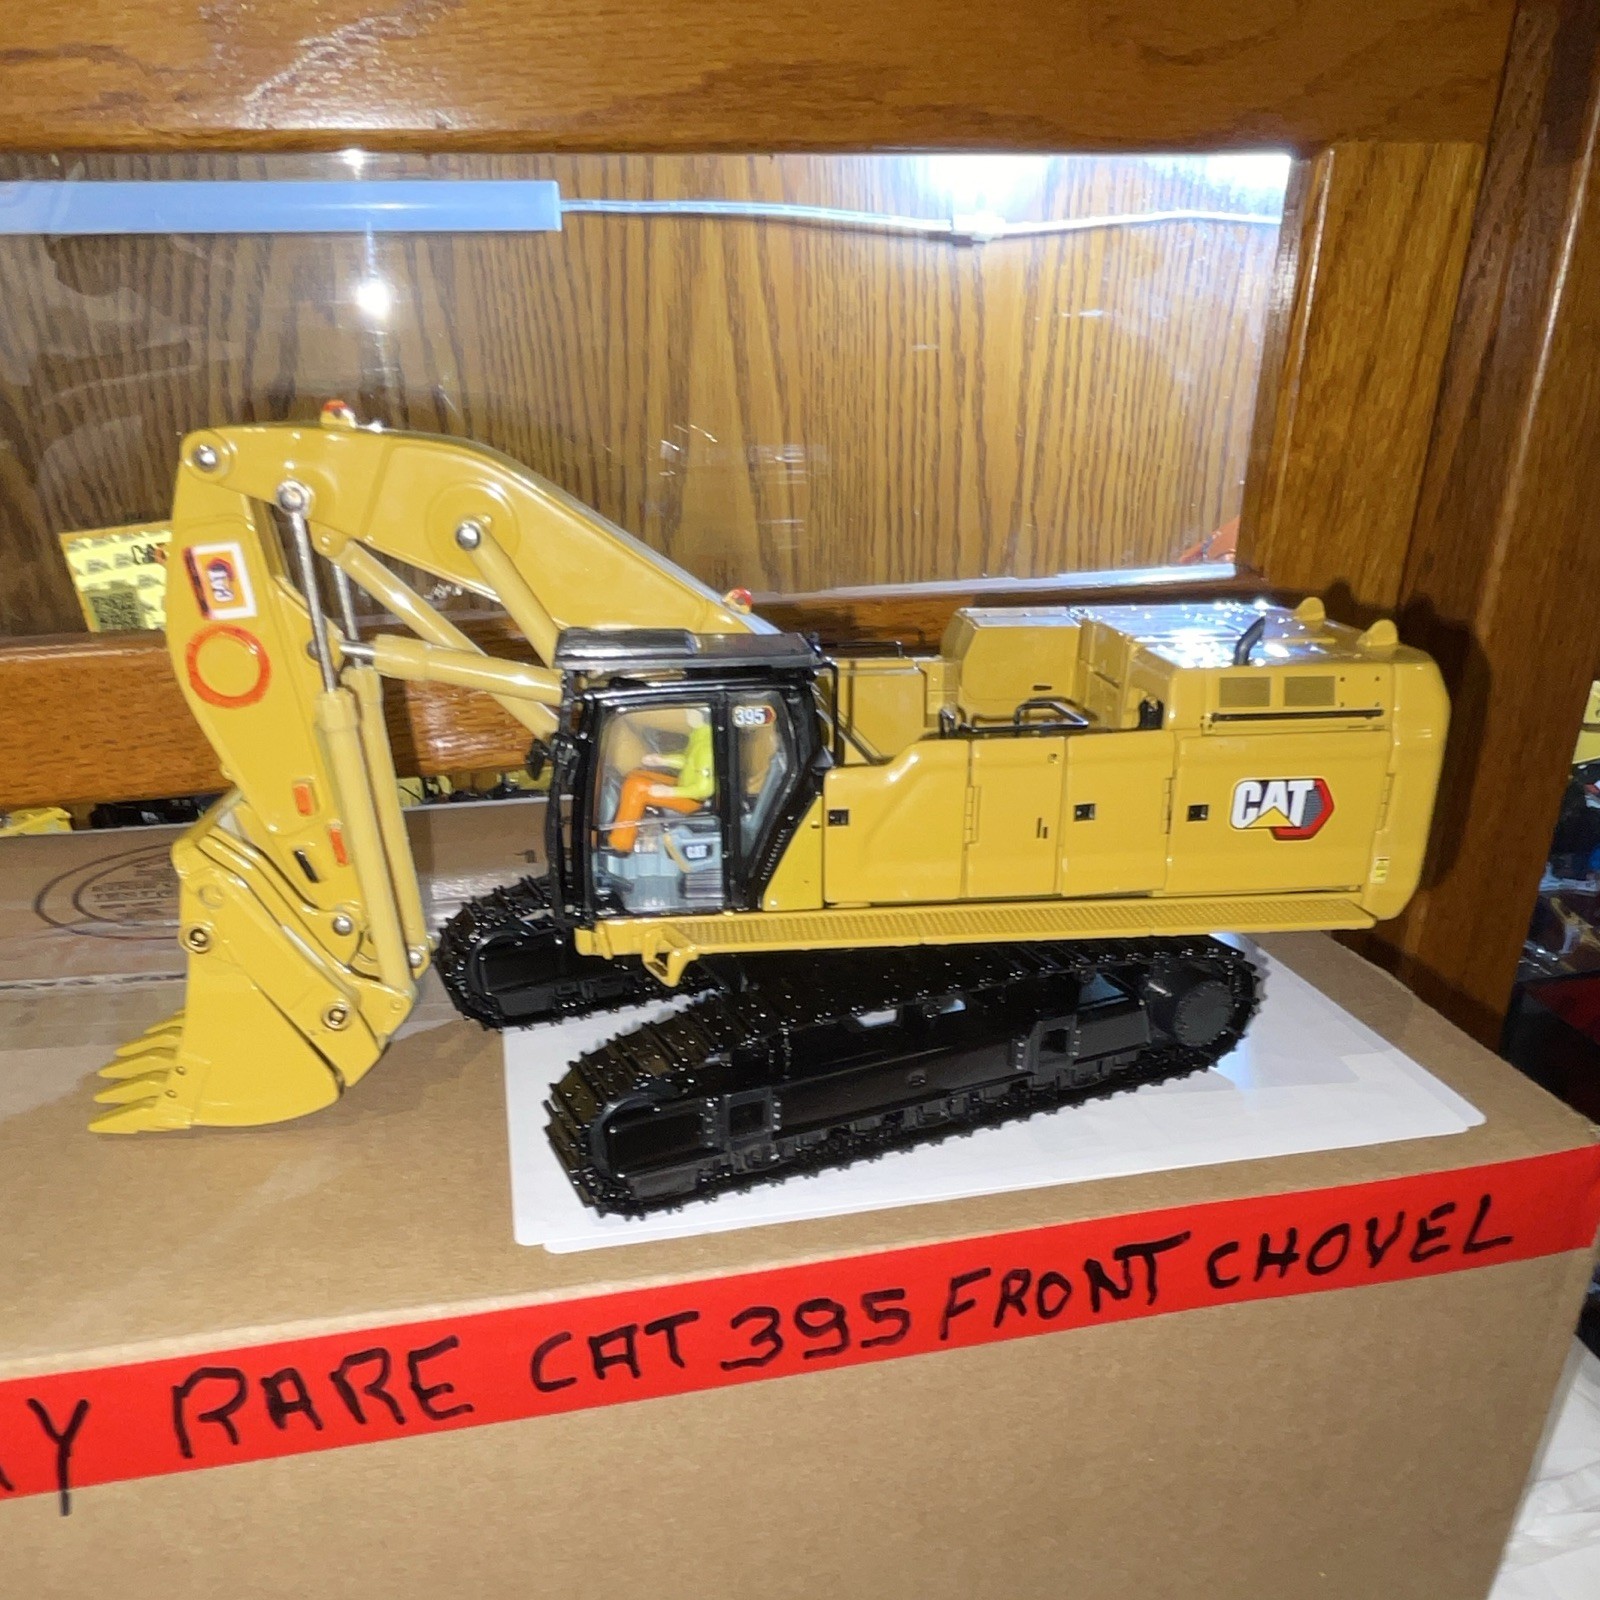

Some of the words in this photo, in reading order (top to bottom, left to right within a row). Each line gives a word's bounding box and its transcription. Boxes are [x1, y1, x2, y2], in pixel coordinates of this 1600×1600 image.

[733, 706, 766, 726] 395
[1230, 779, 1315, 829] CAT
[0, 1397, 90, 1517] Y
[173, 1335, 475, 1458] RARE
[530, 1310, 700, 1393] CAT
[720, 1288, 911, 1370] 395
[939, 1230, 1192, 1341] FRONT
[1206, 1193, 1514, 1289] CHOVEL
